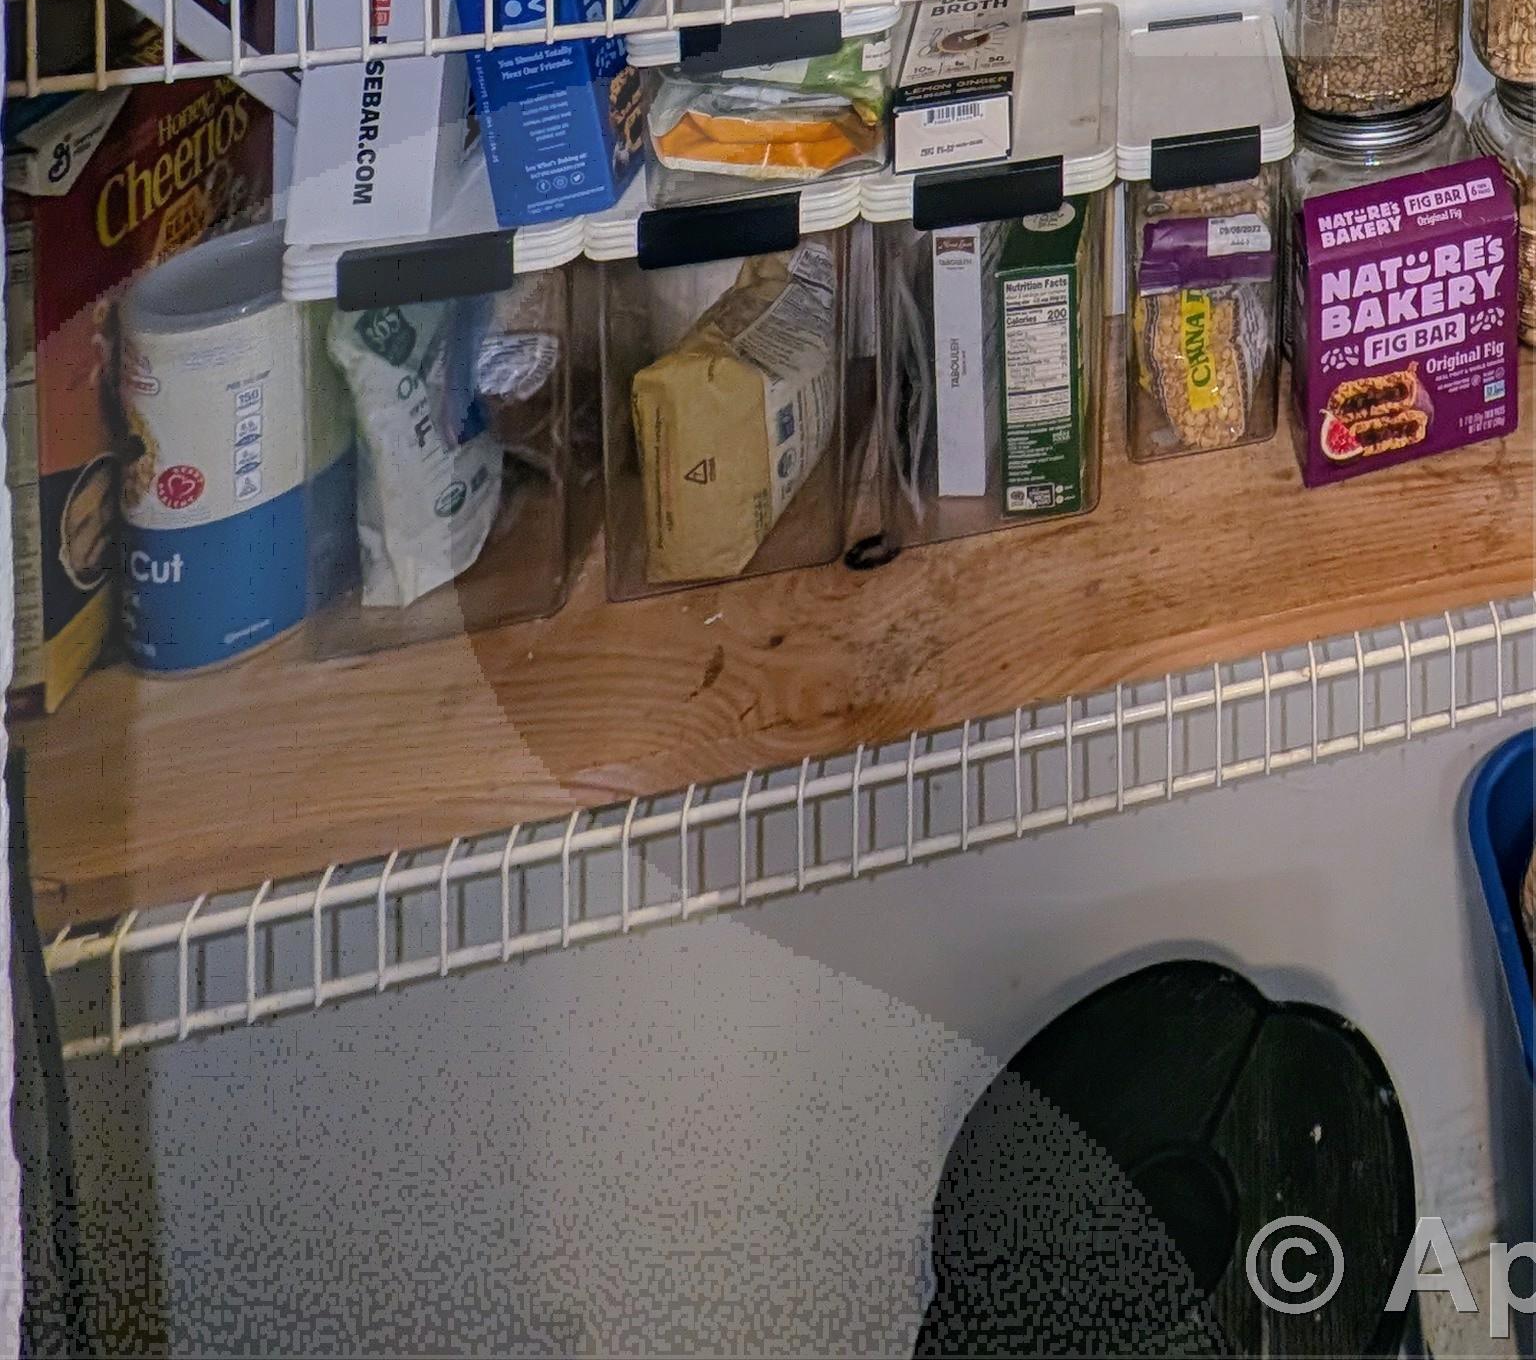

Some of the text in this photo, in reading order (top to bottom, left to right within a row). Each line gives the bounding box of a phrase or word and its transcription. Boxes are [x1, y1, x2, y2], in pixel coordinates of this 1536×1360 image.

[905, 83, 952, 96] LEMON
[956, 76, 1008, 88] GINGER
[353, 36, 388, 205] SEBAR.COM
[96, 91, 250, 248] Cheerios
[1409, 189, 1461, 212] FIG BAR
[1470, 186, 1478, 196] 6
[1320, 215, 1401, 249] BAKERY
[1416, 207, 1463, 227] Original Fig
[1006, 278, 1067, 294] Nutrition Facts
[1321, 264, 1505, 341] BAKERY
[1006, 309, 1067, 326] Calories 200
[1372, 321, 1458, 360] FIG BAR
[1426, 340, 1505, 374] Original Fig
[130, 550, 185, 584] Cut
